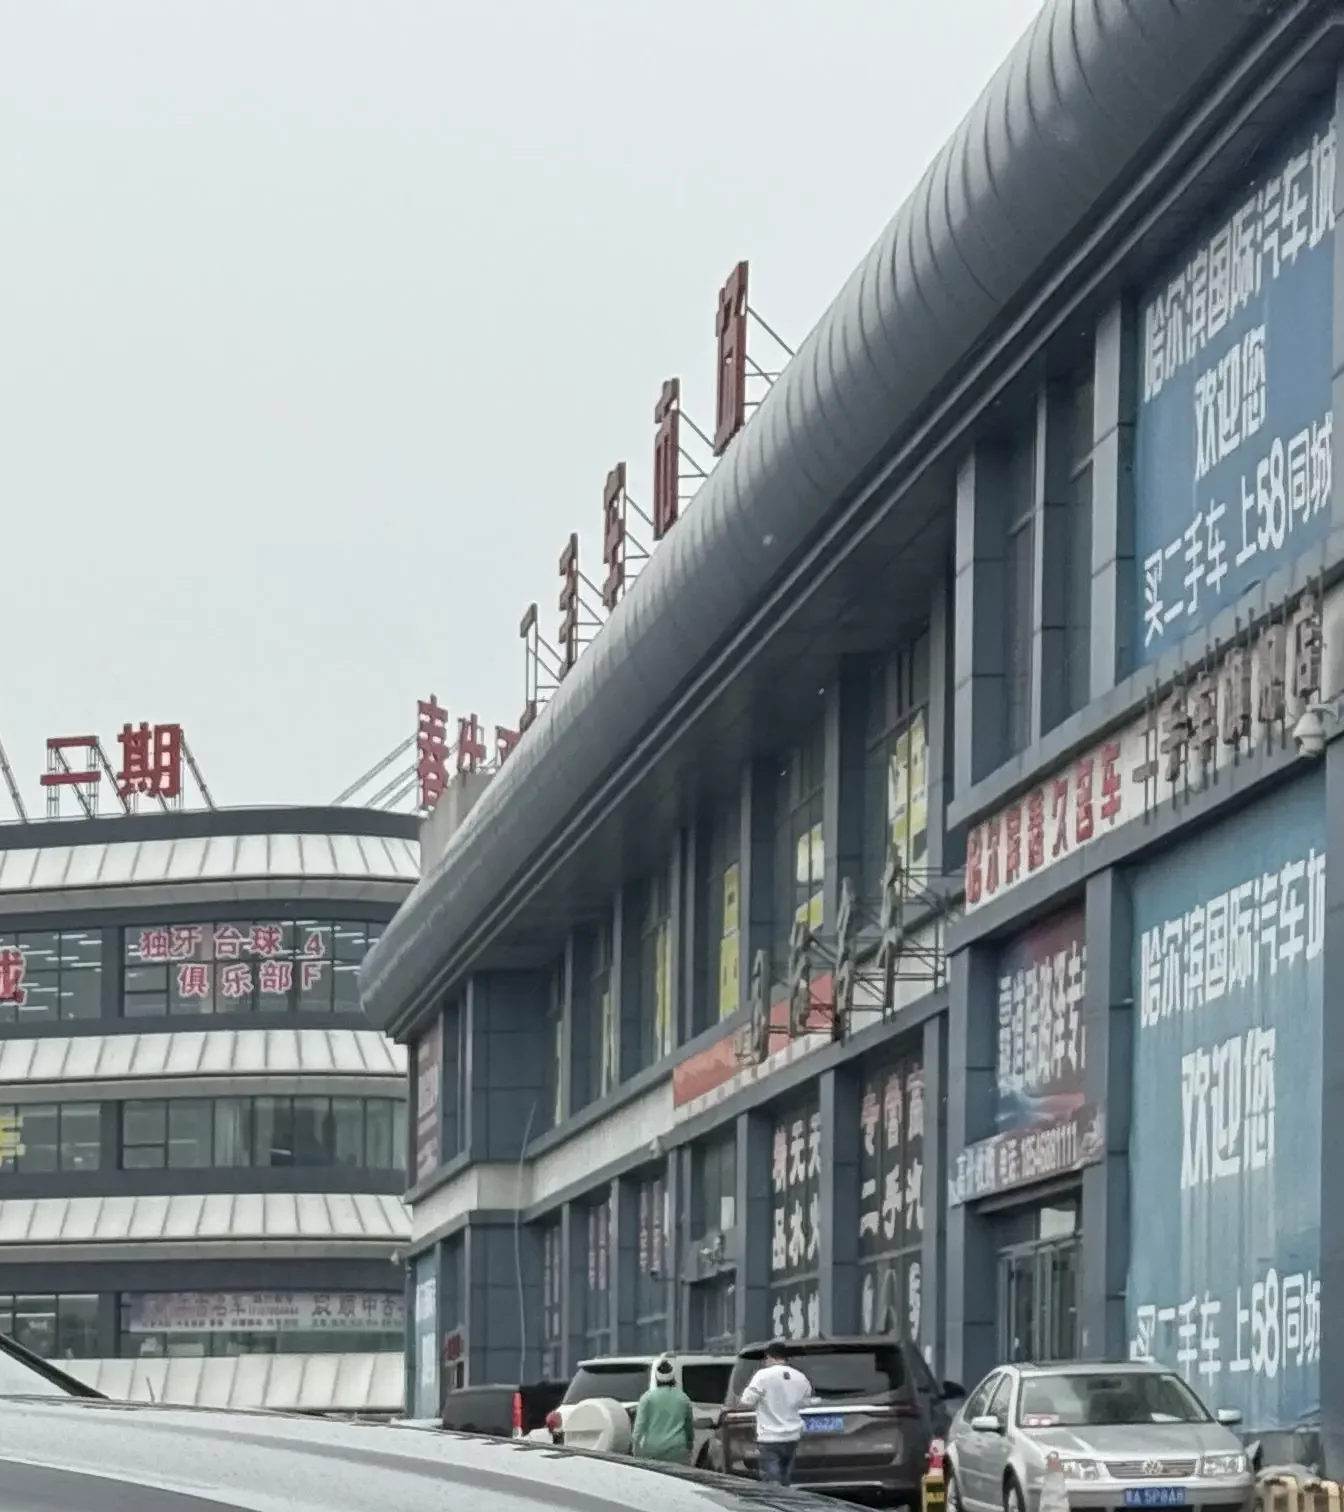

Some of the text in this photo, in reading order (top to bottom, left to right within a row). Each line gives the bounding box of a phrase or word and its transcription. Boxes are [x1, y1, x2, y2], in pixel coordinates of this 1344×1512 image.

[1144, 128, 1336, 403] 哈尔滨国际汽车城
[1194, 323, 1268, 483] 欢迎您
[1144, 411, 1333, 648] 买二手车 上58同城
[40, 721, 182, 799] 二期
[178, 960, 293, 998] 俱乐部
[1181, 1027, 1277, 1190] 欢迎您
